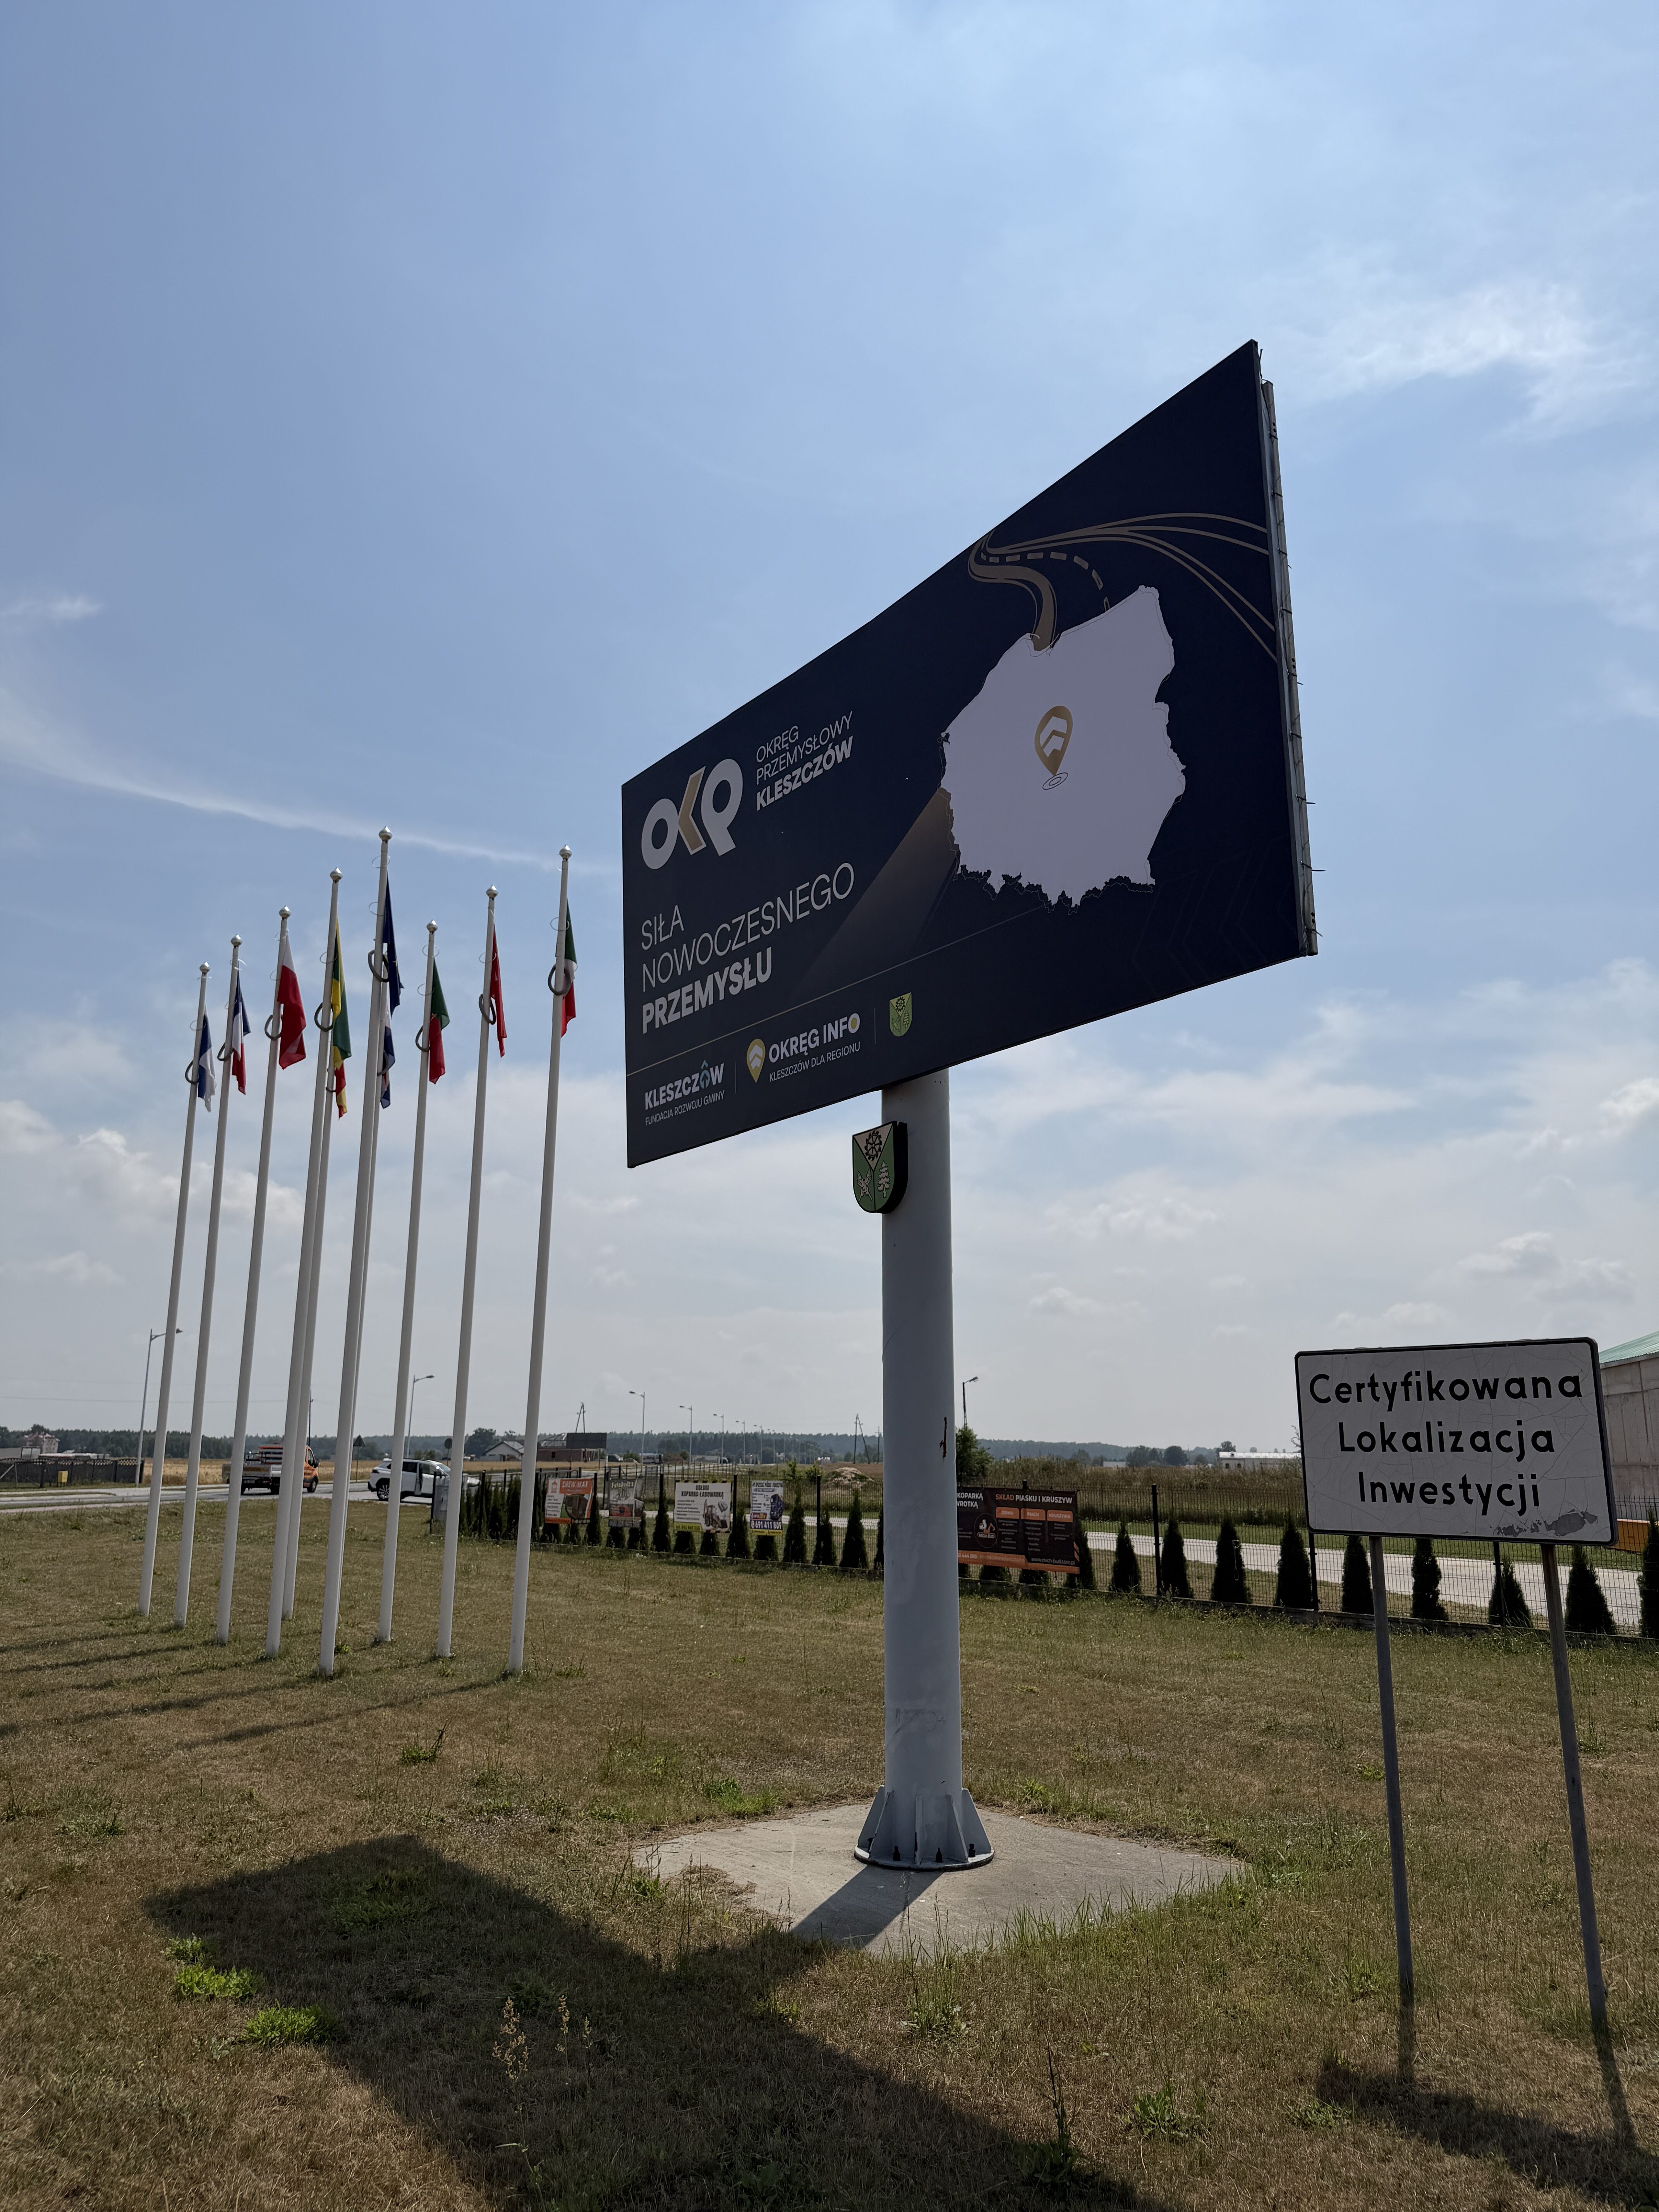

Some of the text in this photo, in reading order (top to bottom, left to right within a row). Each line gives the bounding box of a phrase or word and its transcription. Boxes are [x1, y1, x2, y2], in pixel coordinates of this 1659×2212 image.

[756, 725, 799, 762] OKRĘG
[756, 711, 853, 785] PRZEMYSŁOWY
[756, 736, 853, 811] KLESZCZÓW
[641, 905, 684, 950] SIŁA
[642, 863, 854, 992] NOWOCZESNEGO
[642, 947, 772, 1034] PRZEMYSŁU
[769, 1013, 860, 1063] OKRĘG INFO
[769, 1041, 860, 1082] KLESZCZÓW DLA REGIONU
[645, 1090, 725, 1126] FUNDACJA ROZWOJU GMINY
[1309, 1370, 1583, 1412] Certyfikowana
[1338, 1420, 1555, 1463] Lokalizacja
[1358, 1472, 1540, 1516] Inwestycji
